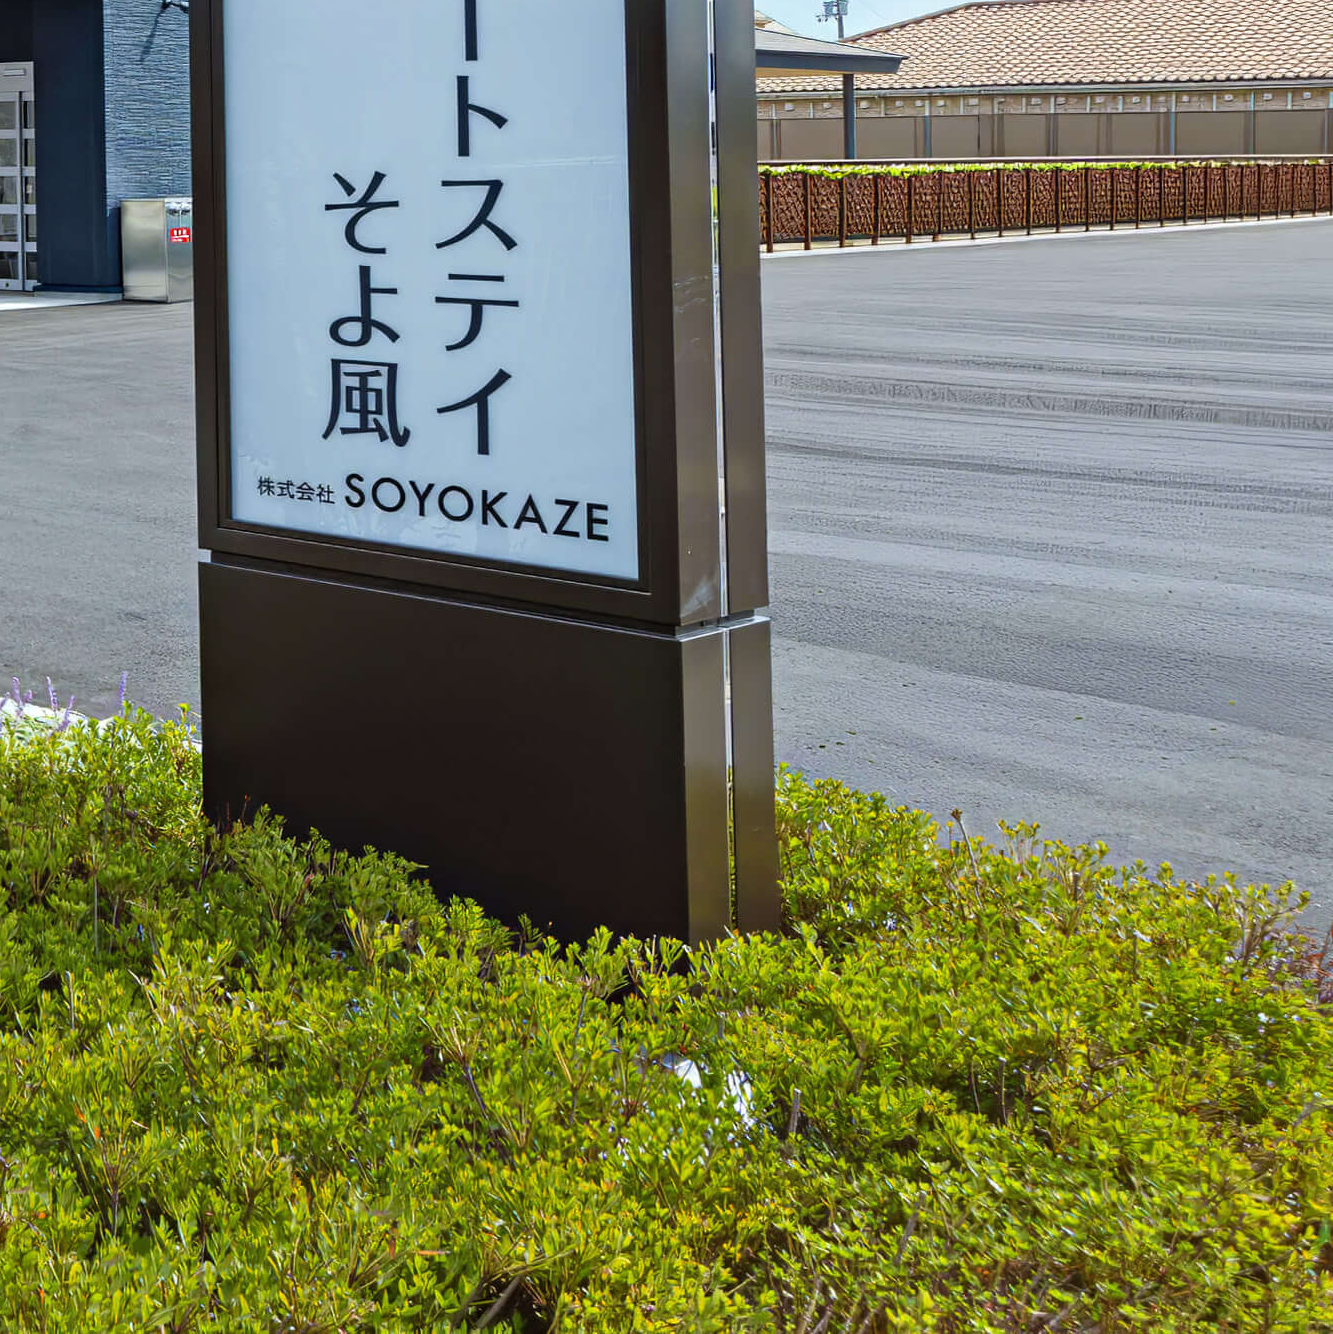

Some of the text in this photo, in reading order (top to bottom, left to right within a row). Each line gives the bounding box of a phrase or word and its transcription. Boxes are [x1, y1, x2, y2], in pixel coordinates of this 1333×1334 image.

[321, 170, 411, 448] そよ風
[256, 473, 610, 542] 株式会社 SOYOKAZE
